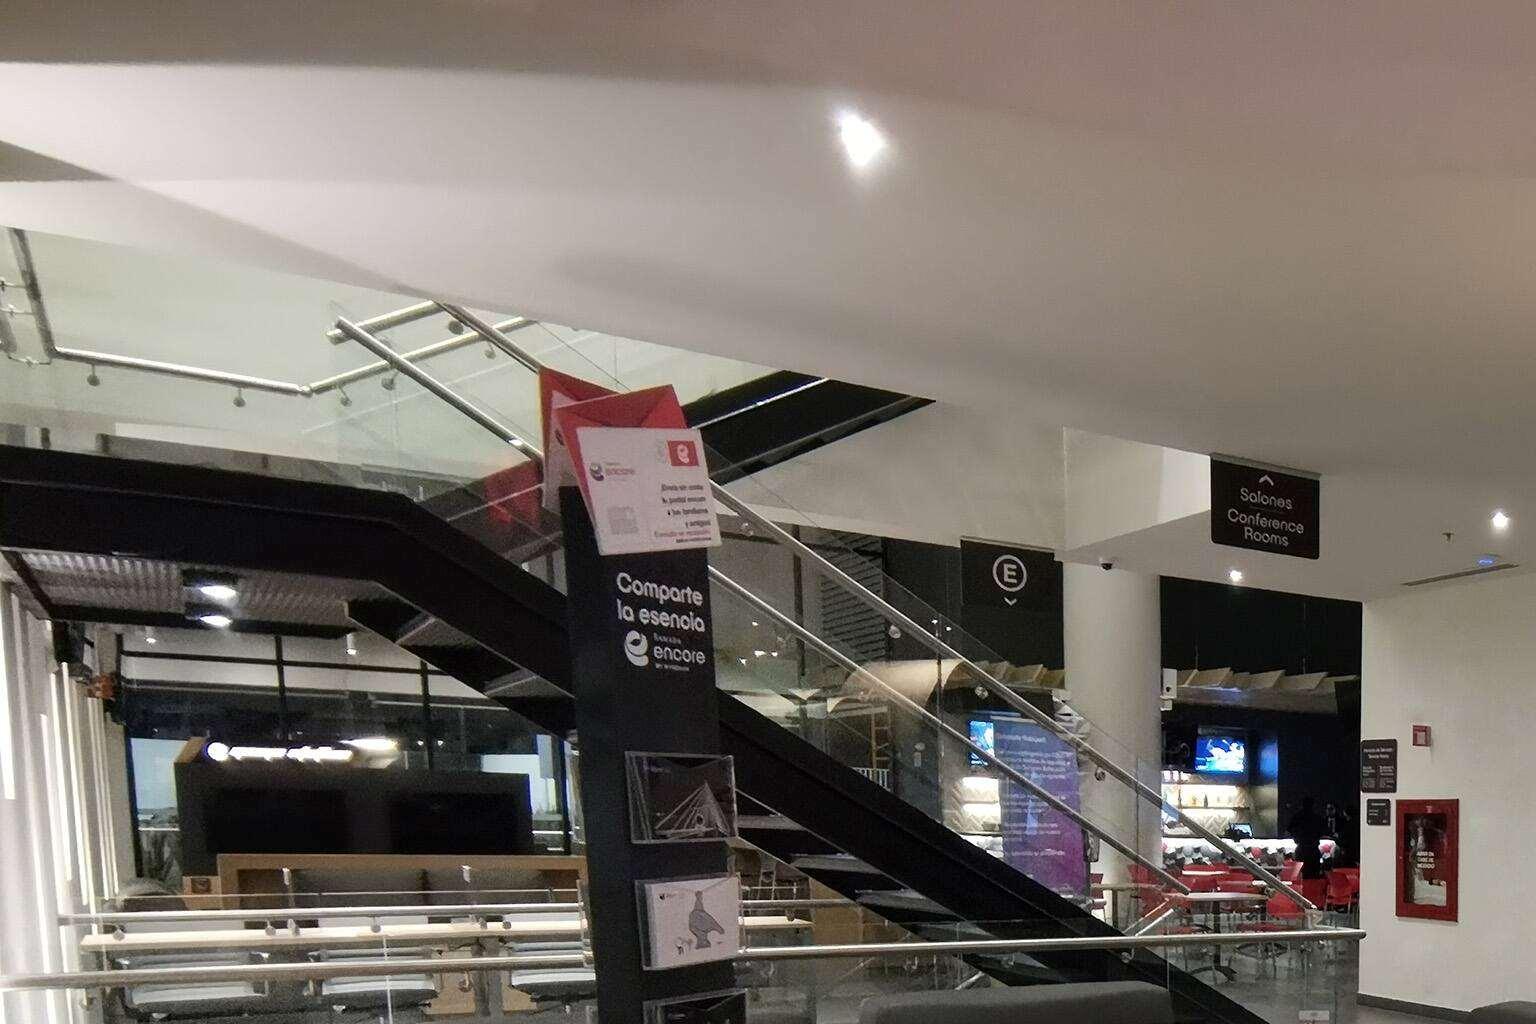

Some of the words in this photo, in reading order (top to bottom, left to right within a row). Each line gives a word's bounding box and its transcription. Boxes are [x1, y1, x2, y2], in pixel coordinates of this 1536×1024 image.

[1240, 487, 1293, 510] Salones
[1227, 508, 1304, 534] Conference
[1244, 526, 1289, 547] Rooms
[1003, 563, 1017, 583] E
[616, 572, 704, 606] Comparte
[616, 598, 635, 622] la
[653, 645, 706, 664] encore
